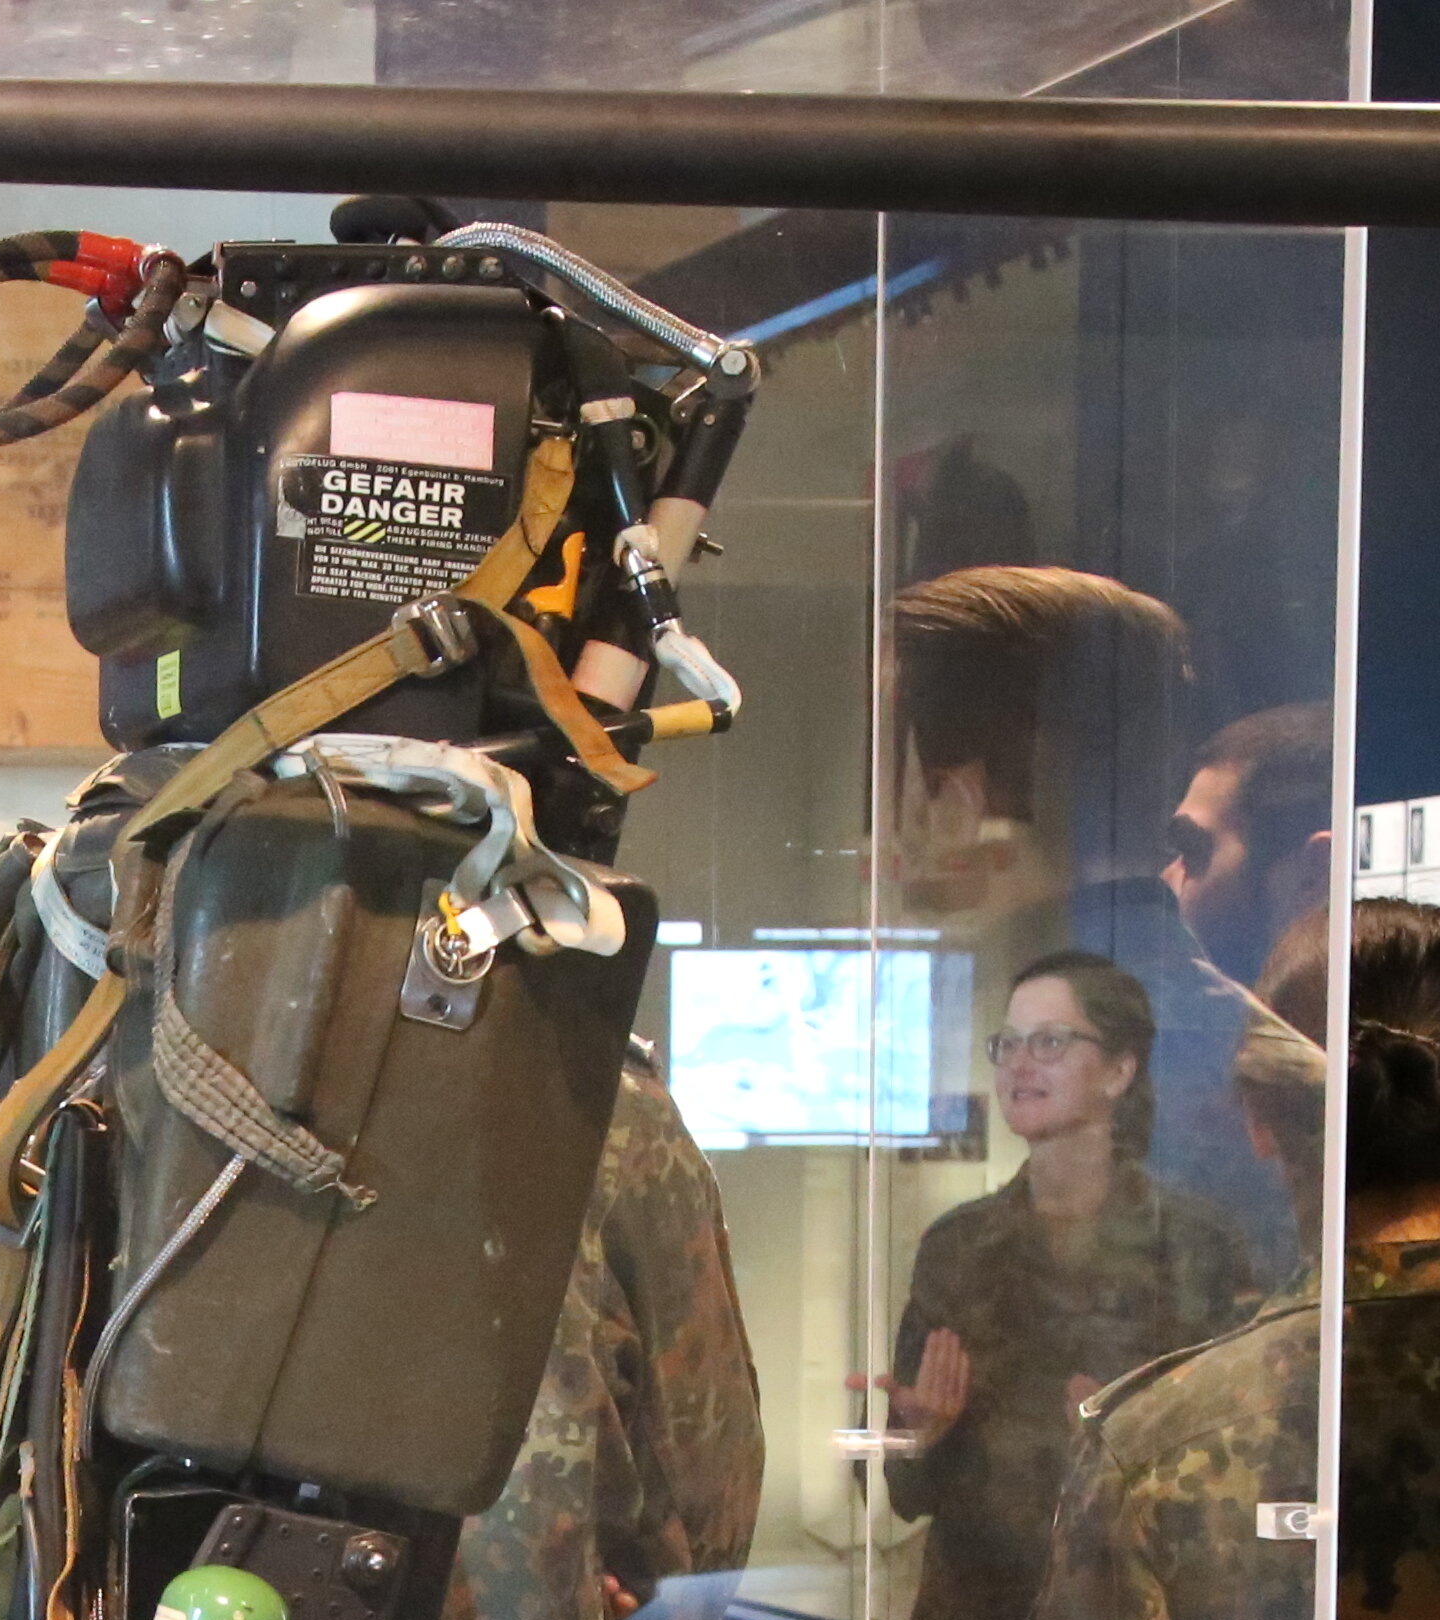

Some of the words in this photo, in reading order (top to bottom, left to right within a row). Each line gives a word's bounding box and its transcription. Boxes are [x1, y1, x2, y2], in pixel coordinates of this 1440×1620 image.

[340, 460, 367, 470] GmbH
[464, 474, 505, 486] Hamburg
[323, 470, 465, 504] GEFAHR
[321, 493, 463, 528] DANGER
[386, 525, 461, 541] ABZUGSGRIFFE
[386, 535, 417, 546] THESE
[420, 538, 452, 549] FIRING
[312, 565, 327, 575] THE
[329, 567, 348, 577] SEAT
[385, 574, 424, 587] ACTUATOR
[426, 579, 448, 589] MUST
[349, 579, 364, 589] FOR
[365, 582, 387, 591] MORE
[389, 584, 409, 594] THAN
[340, 588, 350, 596] OF
[352, 589, 367, 598] TEN
[369, 591, 403, 603] MINUTES
